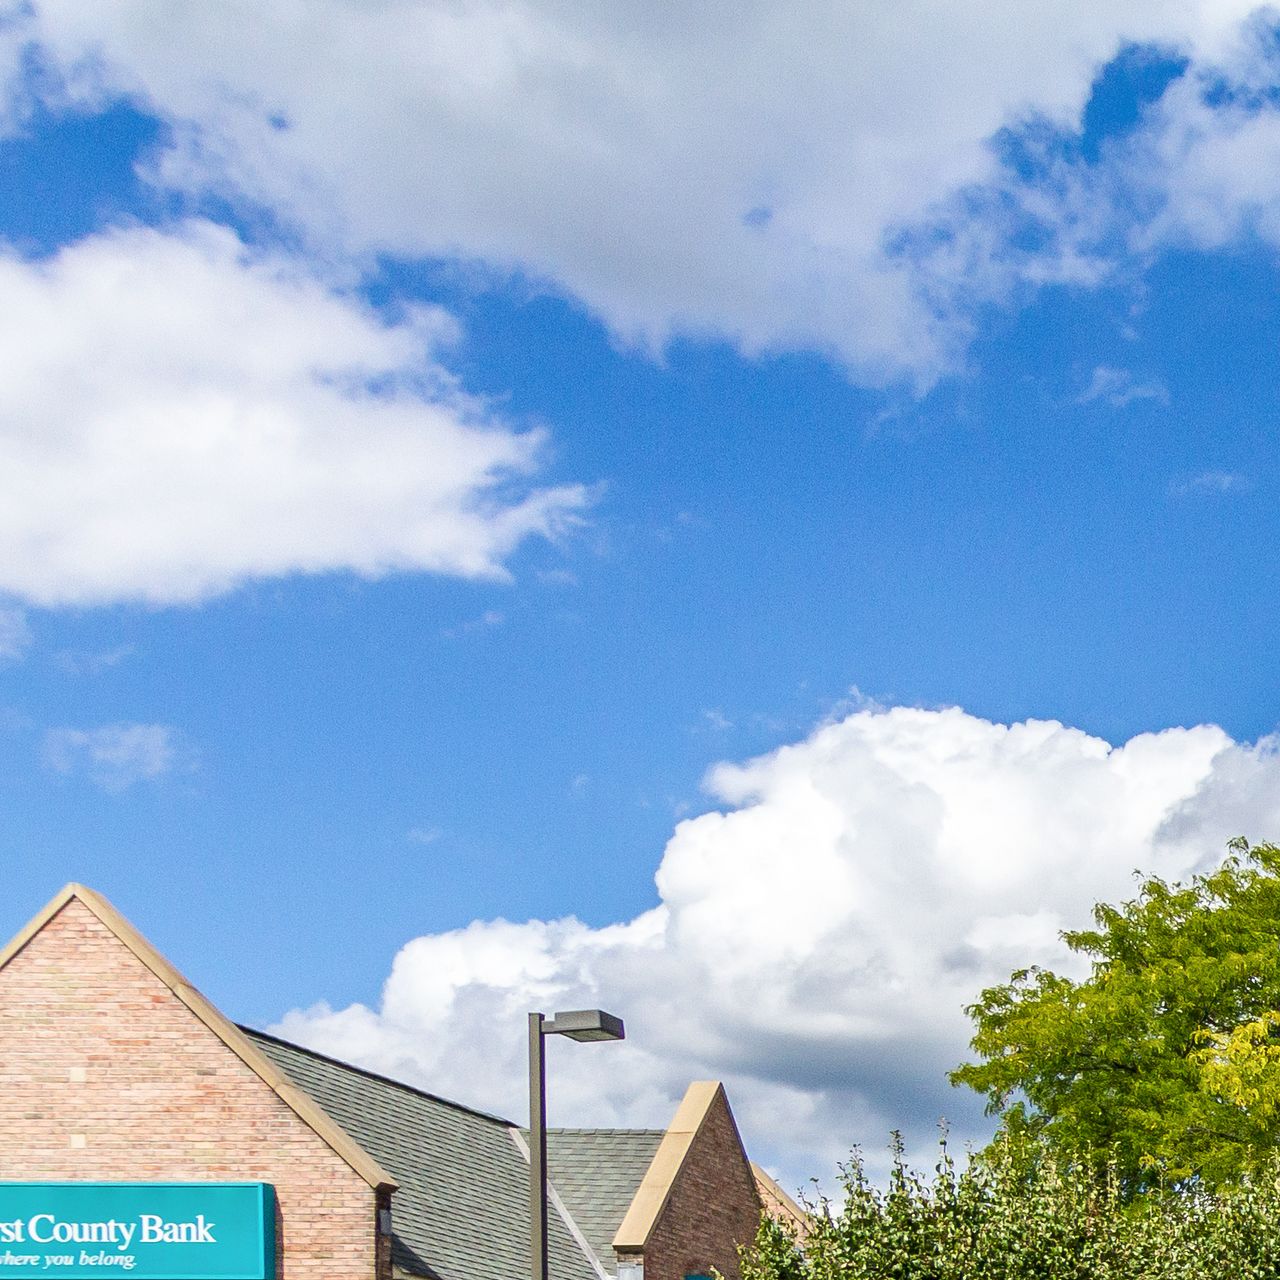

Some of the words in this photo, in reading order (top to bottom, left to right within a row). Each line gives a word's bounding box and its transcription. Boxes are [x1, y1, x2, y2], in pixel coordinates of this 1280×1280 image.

[0, 1219, 26, 1242] st
[28, 1213, 137, 1251] County
[139, 1214, 217, 1243] Bank
[42, 1254, 74, 1270] you
[78, 1250, 138, 1270] belong.
